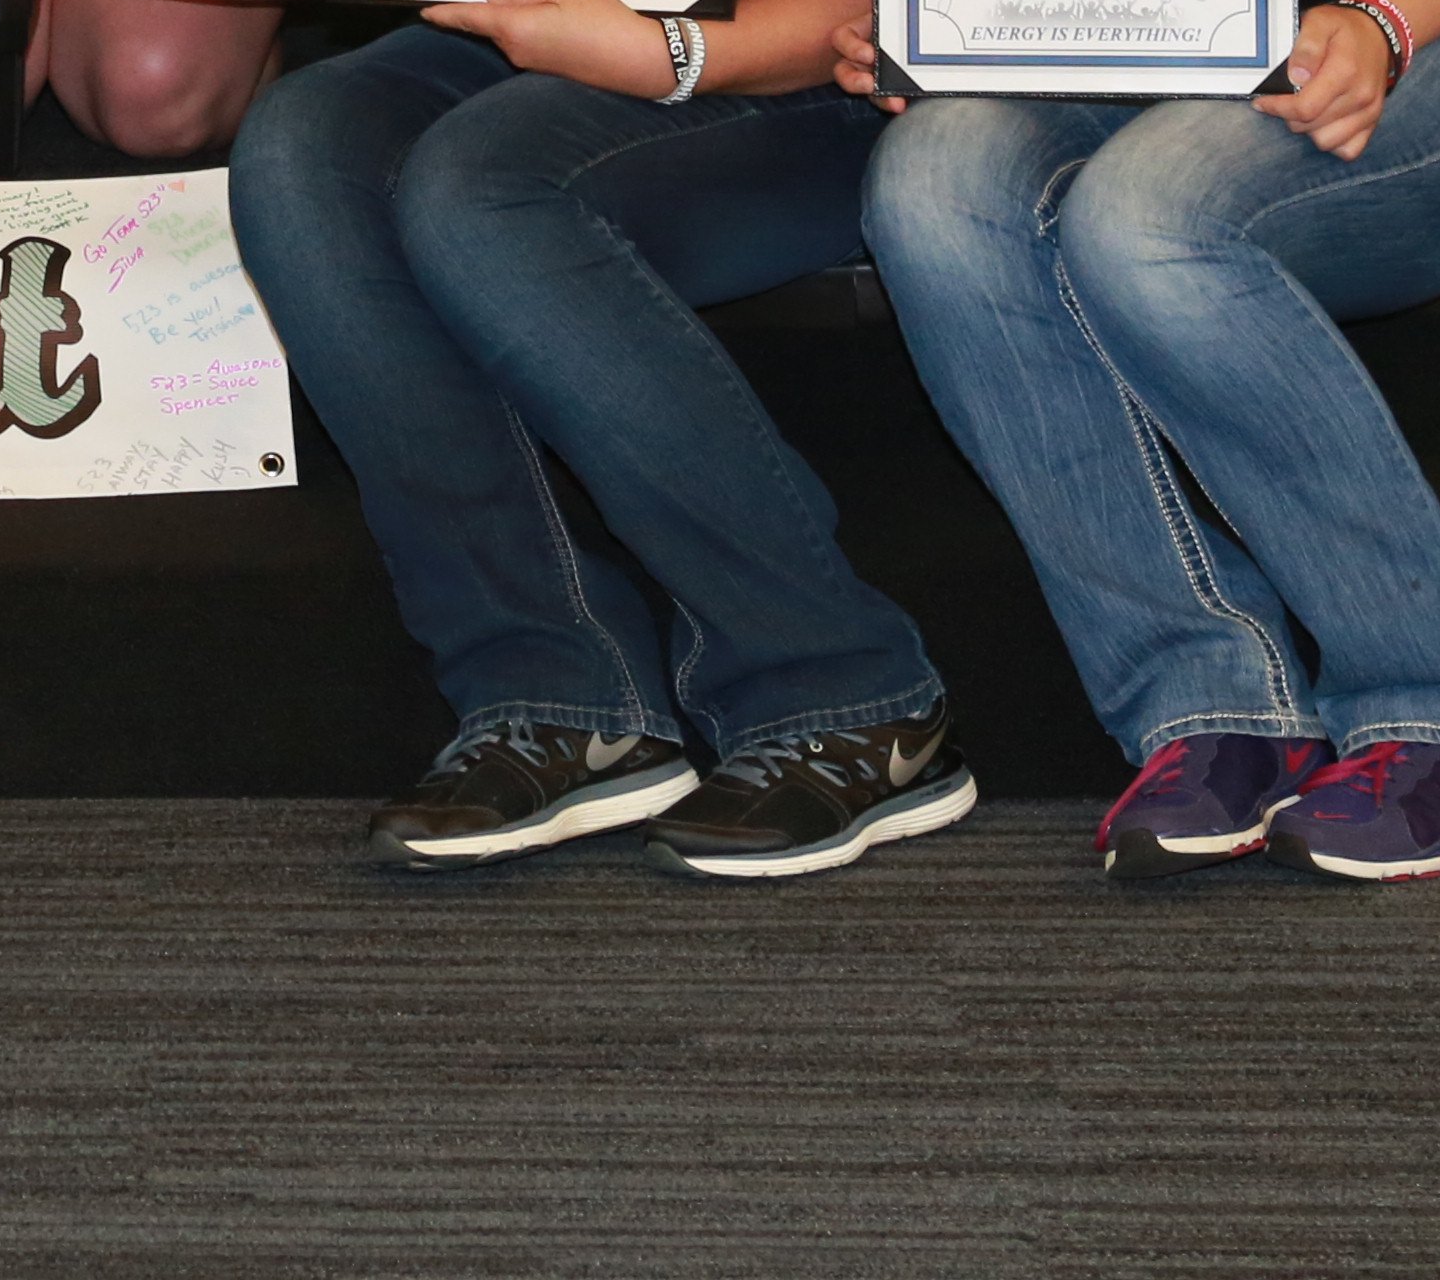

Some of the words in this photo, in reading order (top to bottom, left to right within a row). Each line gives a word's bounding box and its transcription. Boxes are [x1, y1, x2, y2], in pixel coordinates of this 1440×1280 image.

[971, 26, 1047, 40] ENERGY
[1051, 27, 1068, 40] IS
[1073, 27, 1201, 41] EVERYTHING!
[150, 374, 189, 392] 523
